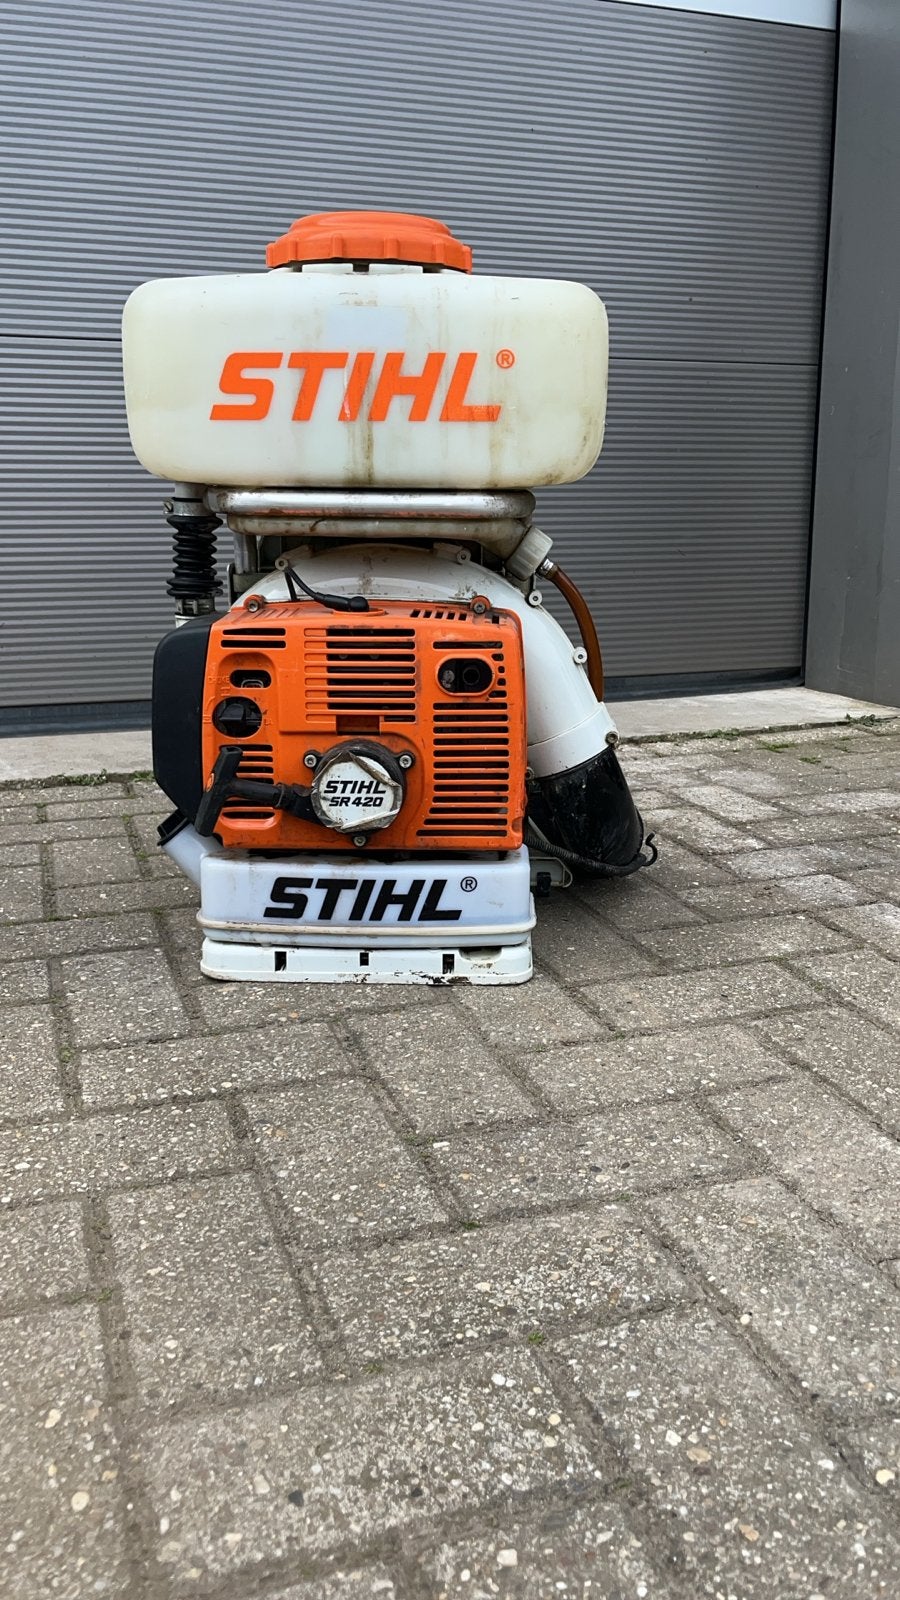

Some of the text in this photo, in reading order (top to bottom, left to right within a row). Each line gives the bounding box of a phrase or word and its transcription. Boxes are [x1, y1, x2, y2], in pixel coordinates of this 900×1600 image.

[324, 780, 386, 794] STIHL
[329, 796, 384, 807] SR 420
